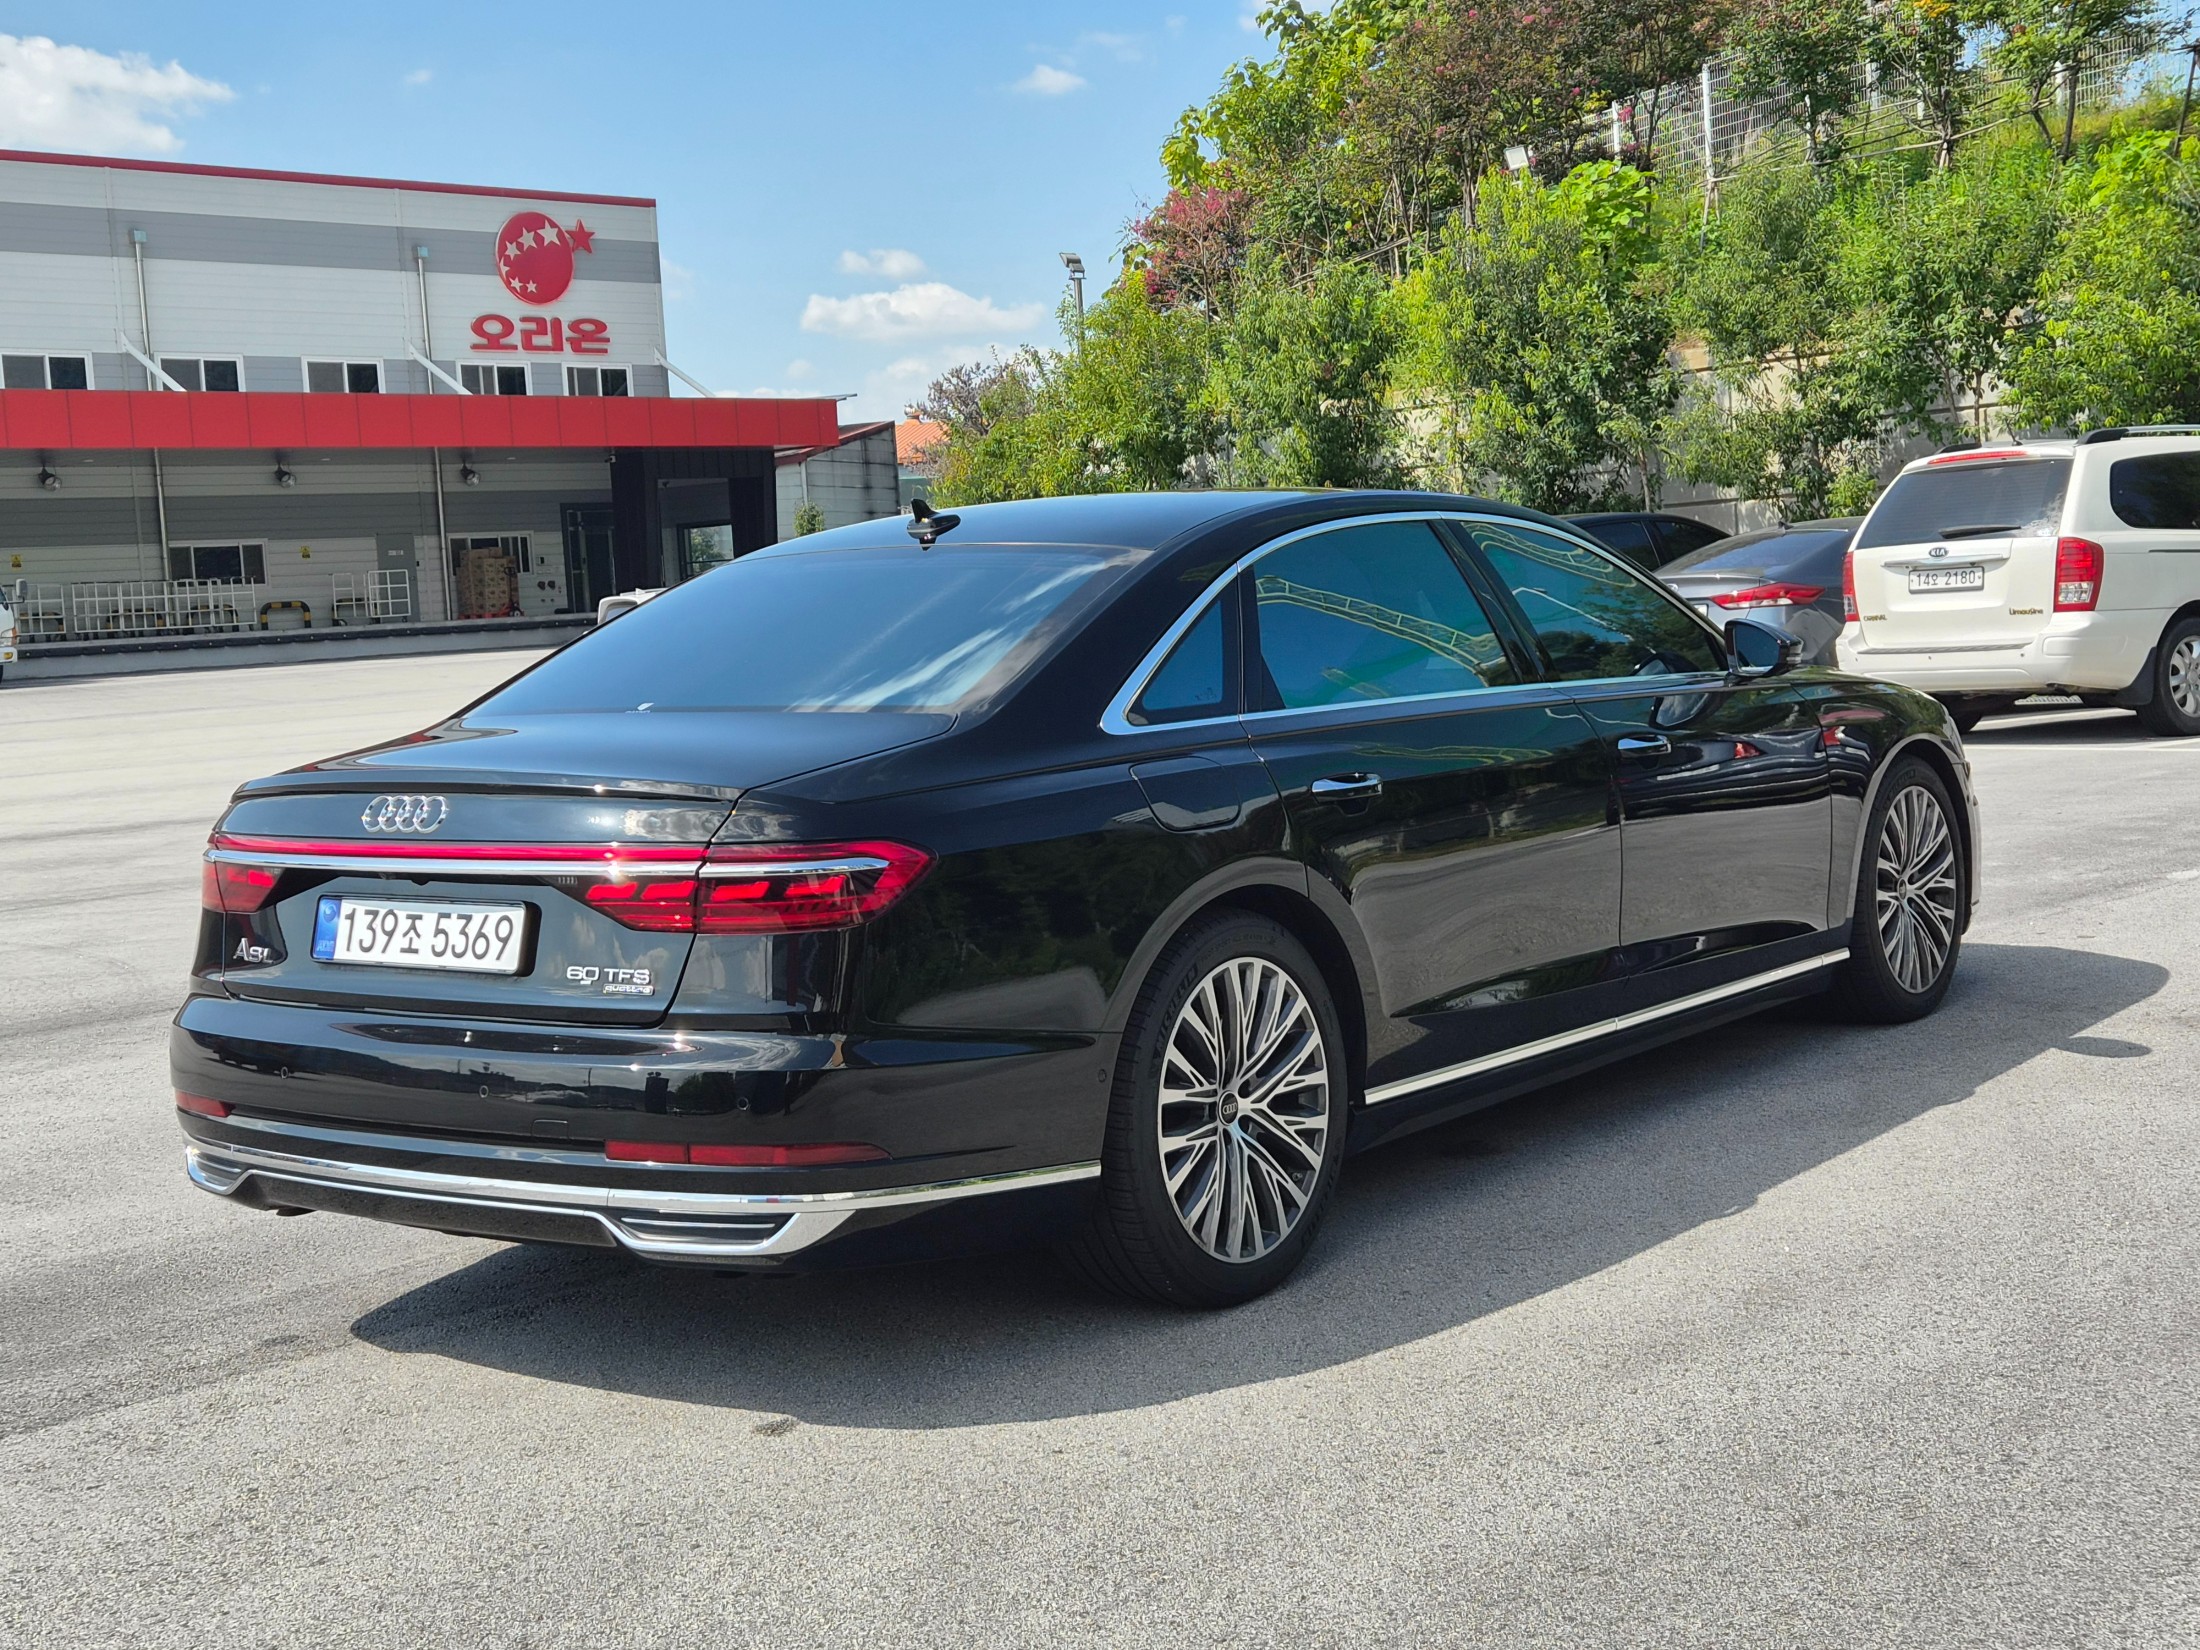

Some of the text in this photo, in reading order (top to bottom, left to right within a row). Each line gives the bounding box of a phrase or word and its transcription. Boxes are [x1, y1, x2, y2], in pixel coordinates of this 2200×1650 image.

[469, 313, 612, 354] 오리온
[1929, 548, 1947, 557] KIA
[1916, 569, 1976, 587] 14오 2180
[343, 907, 515, 962] 139조 5369
[232, 937, 274, 964] A8L
[566, 965, 600, 981] 60
